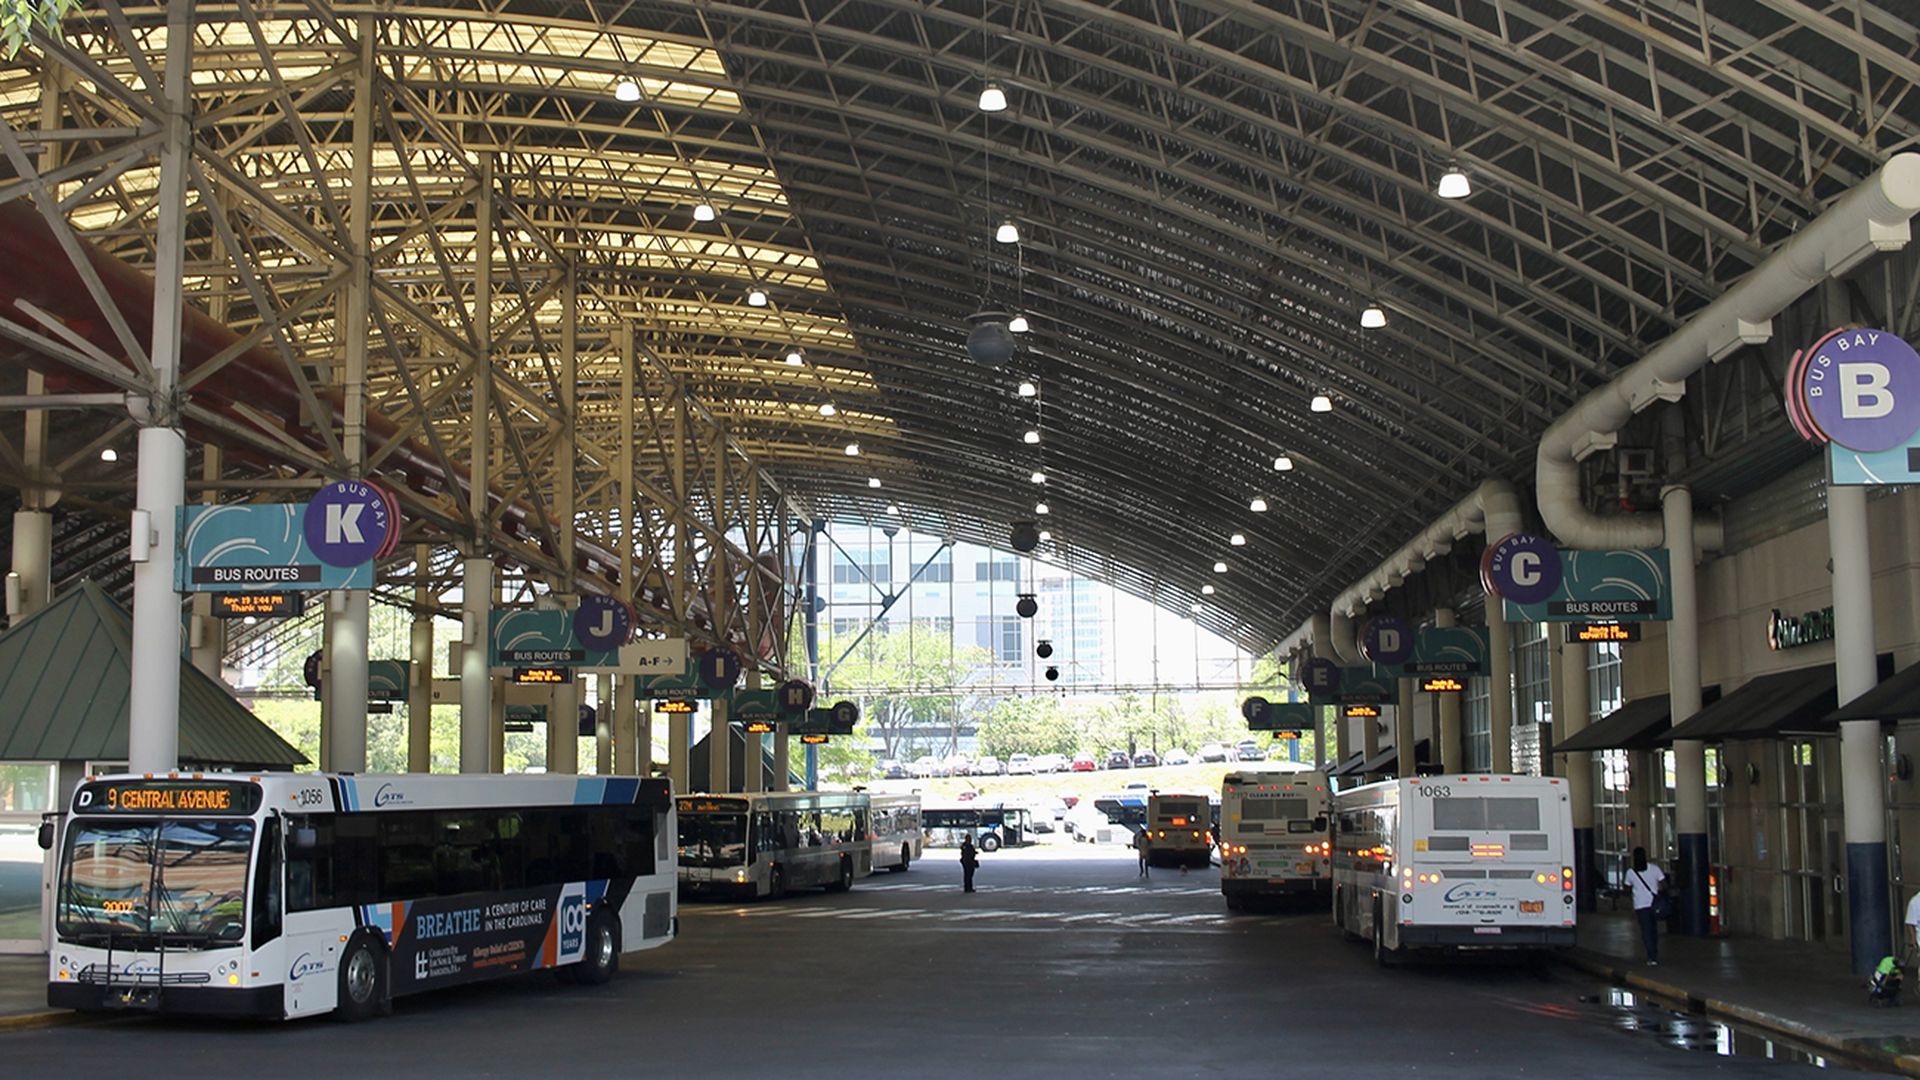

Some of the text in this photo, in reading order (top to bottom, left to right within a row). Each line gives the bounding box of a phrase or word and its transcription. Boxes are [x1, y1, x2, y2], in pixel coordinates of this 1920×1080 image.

[1810, 333, 1879, 397] BUS BAY
[1838, 362, 1894, 419] B
[338, 483, 386, 530] BUS BAY
[325, 503, 366, 544] K
[1492, 535, 1536, 571] BUS BAY
[214, 568, 299, 581] BUS ROUTES
[1510, 551, 1541, 586] C
[231, 604, 255, 612] Thank
[595, 597, 614, 606] BUS
[1566, 602, 1638, 613] BUS ROUTES
[588, 609, 613, 637] J
[1378, 628, 1401, 652] D
[513, 651, 571, 660] BUS ROUTES
[1434, 663, 1468, 671] ROUTES
[1313, 667, 1328, 686] E
[669, 688, 698, 696] ROUTES
[787, 688, 803, 704] H
[837, 707, 851, 721] G
[1250, 703, 1263, 717] F
[79, 790, 93, 807] D
[108, 788, 229, 810] 9 CENTRAL AVENUE
[301, 789, 323, 805] 1056
[1418, 785, 1451, 798] 1063
[485, 898, 547, 918] A CENTURY OF CARE
[416, 908, 481, 940] BREATHE
[485, 919, 494, 932] IN
[494, 918, 506, 931] THE
[562, 904, 584, 935] 100
[562, 938, 579, 949] YEARS
